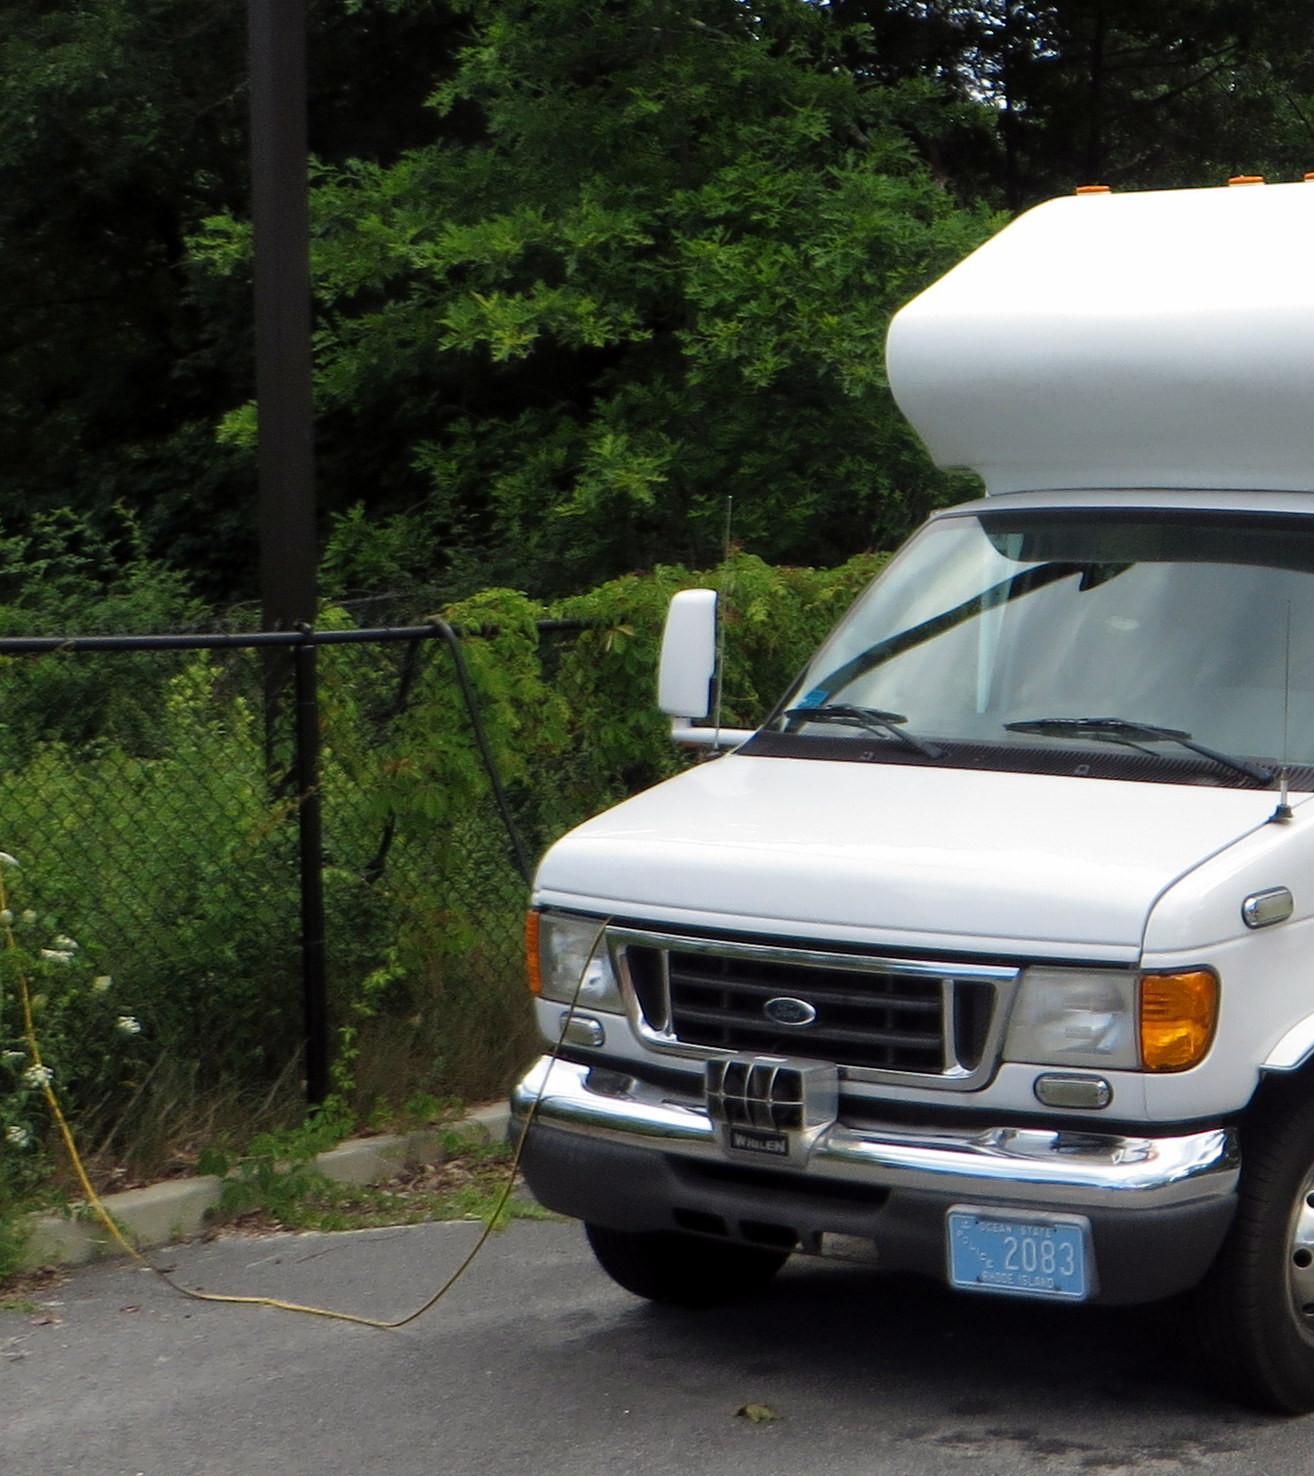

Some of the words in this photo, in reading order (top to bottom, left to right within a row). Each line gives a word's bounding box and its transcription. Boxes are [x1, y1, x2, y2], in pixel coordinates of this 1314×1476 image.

[980, 1221, 1012, 1234] OCEAN
[1020, 1225, 1052, 1238] STATE
[1004, 1236, 1075, 1276] 2083
[981, 1270, 1014, 1285] RHODE
[1019, 1273, 1055, 1289] ISLAND
